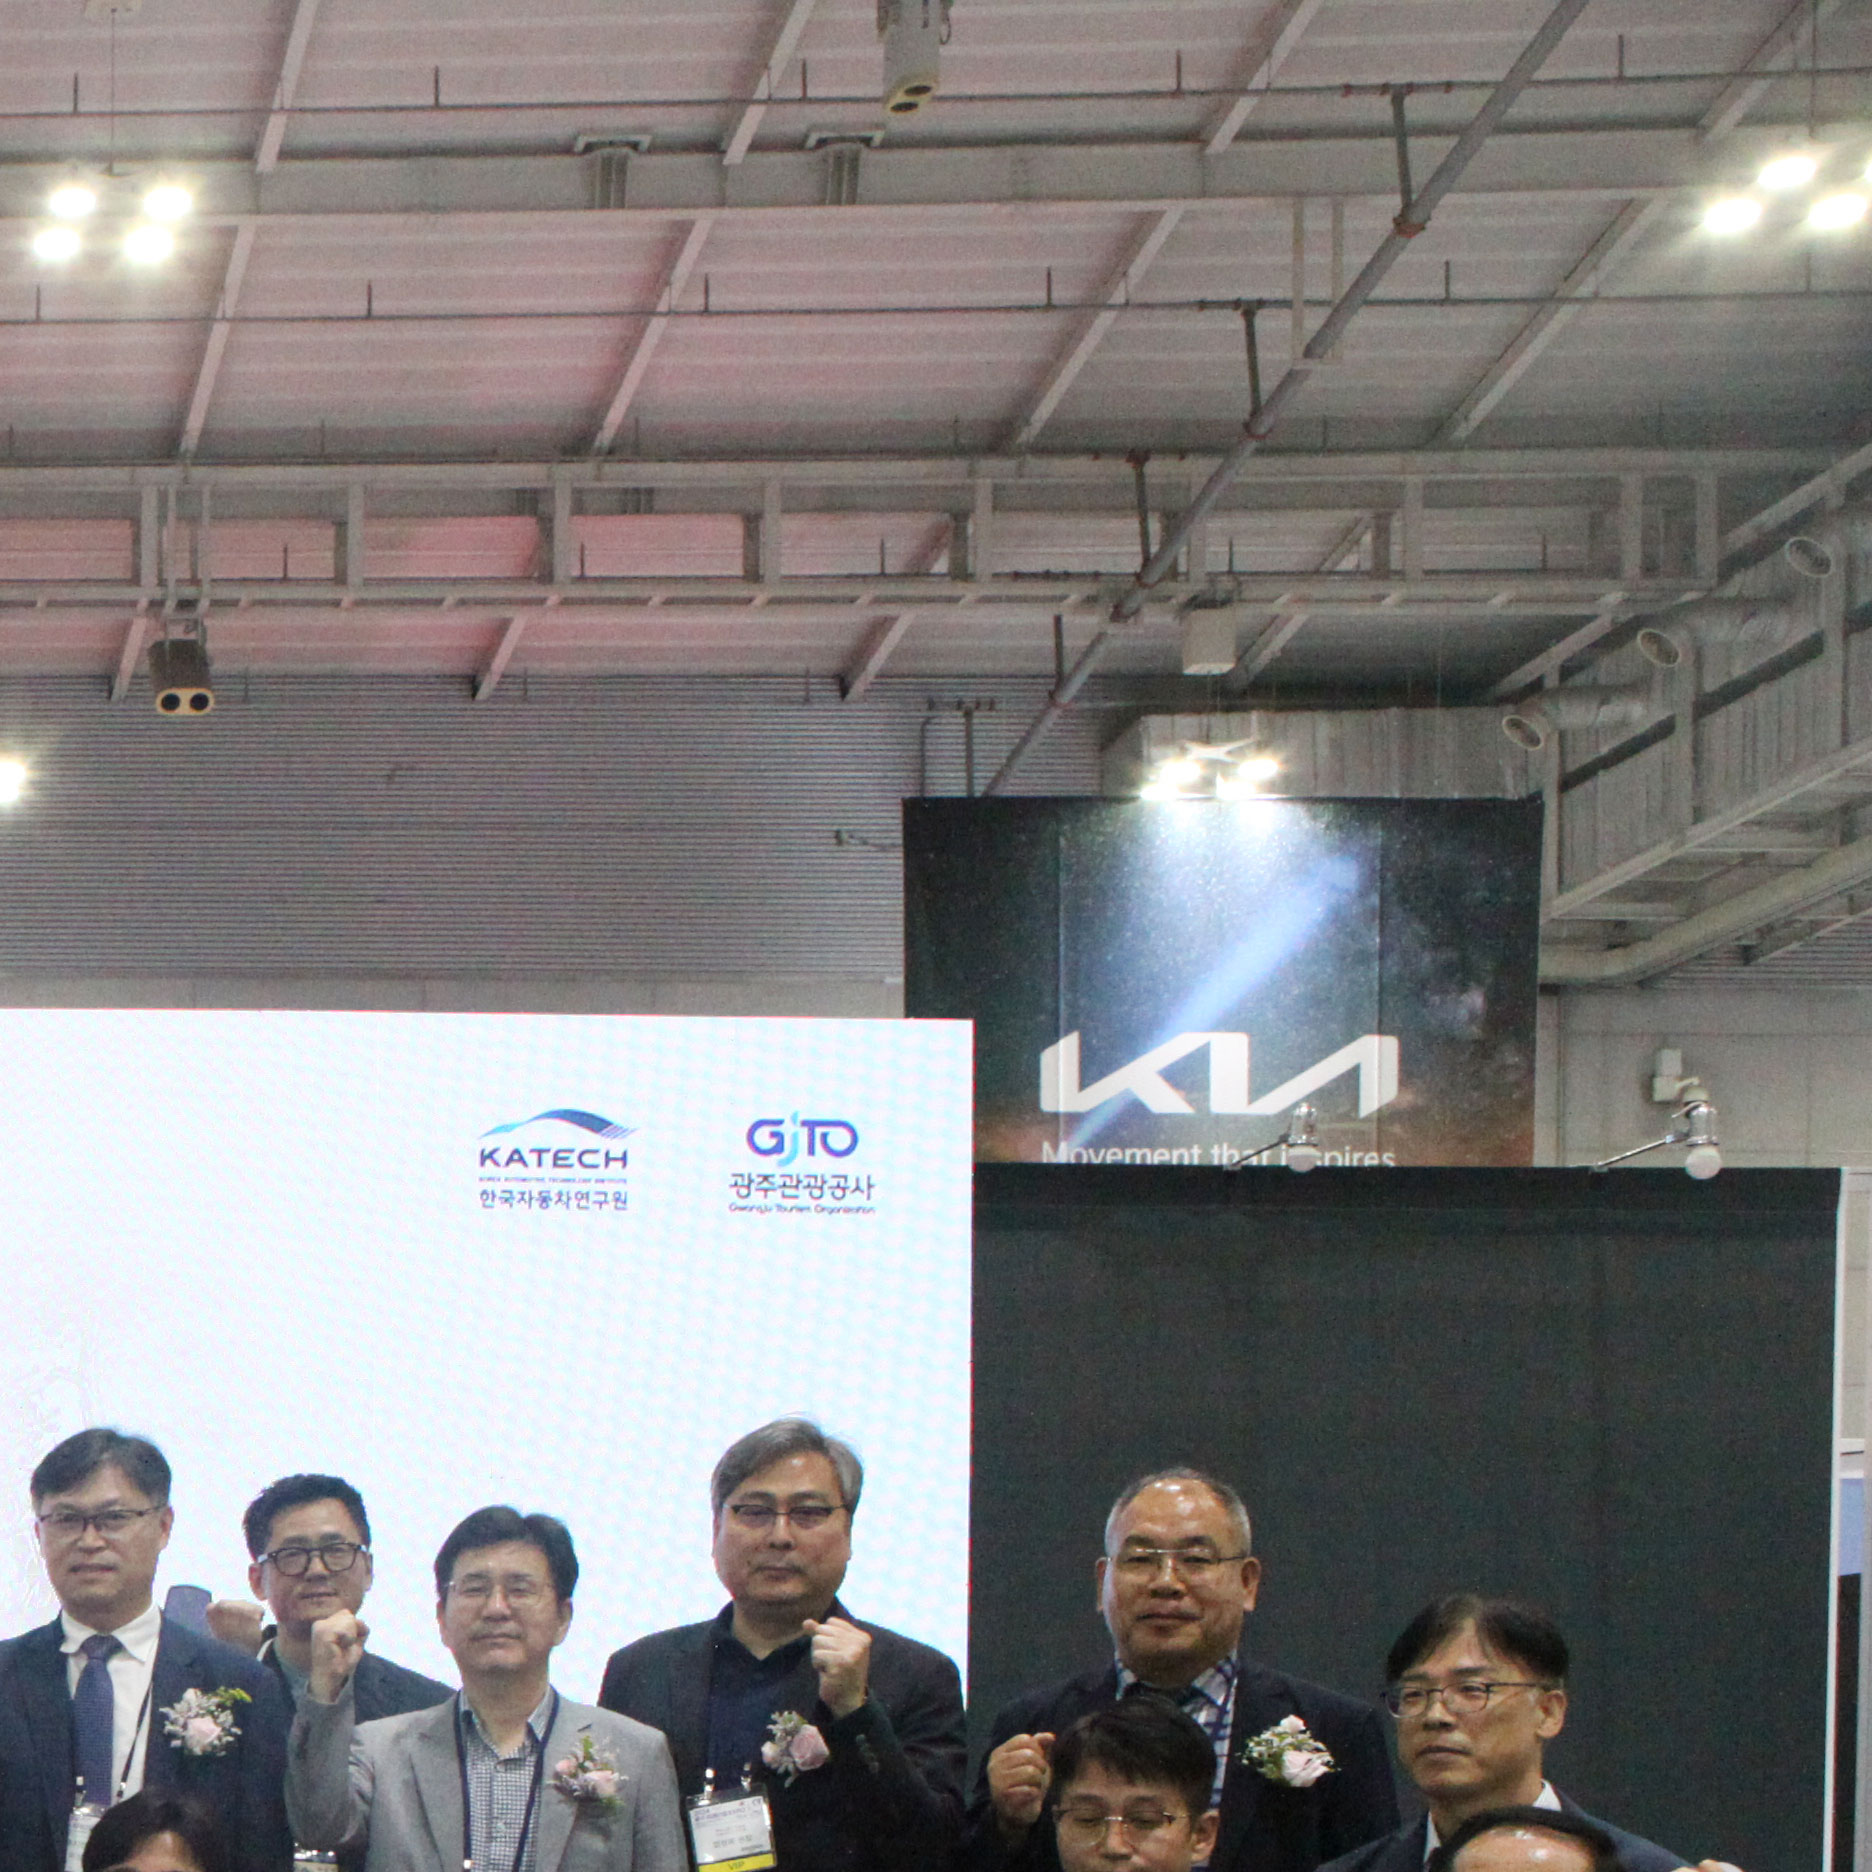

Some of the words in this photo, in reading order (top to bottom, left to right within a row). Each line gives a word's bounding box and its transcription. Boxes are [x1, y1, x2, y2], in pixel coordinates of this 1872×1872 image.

[479, 1148, 628, 1169] KATECH
[1042, 1140, 1208, 1164] Movement
[1282, 1144, 1397, 1167] ipires
[729, 1172, 875, 1201] 광주관광공사
[479, 1188, 628, 1211] 한국자동차연구원
